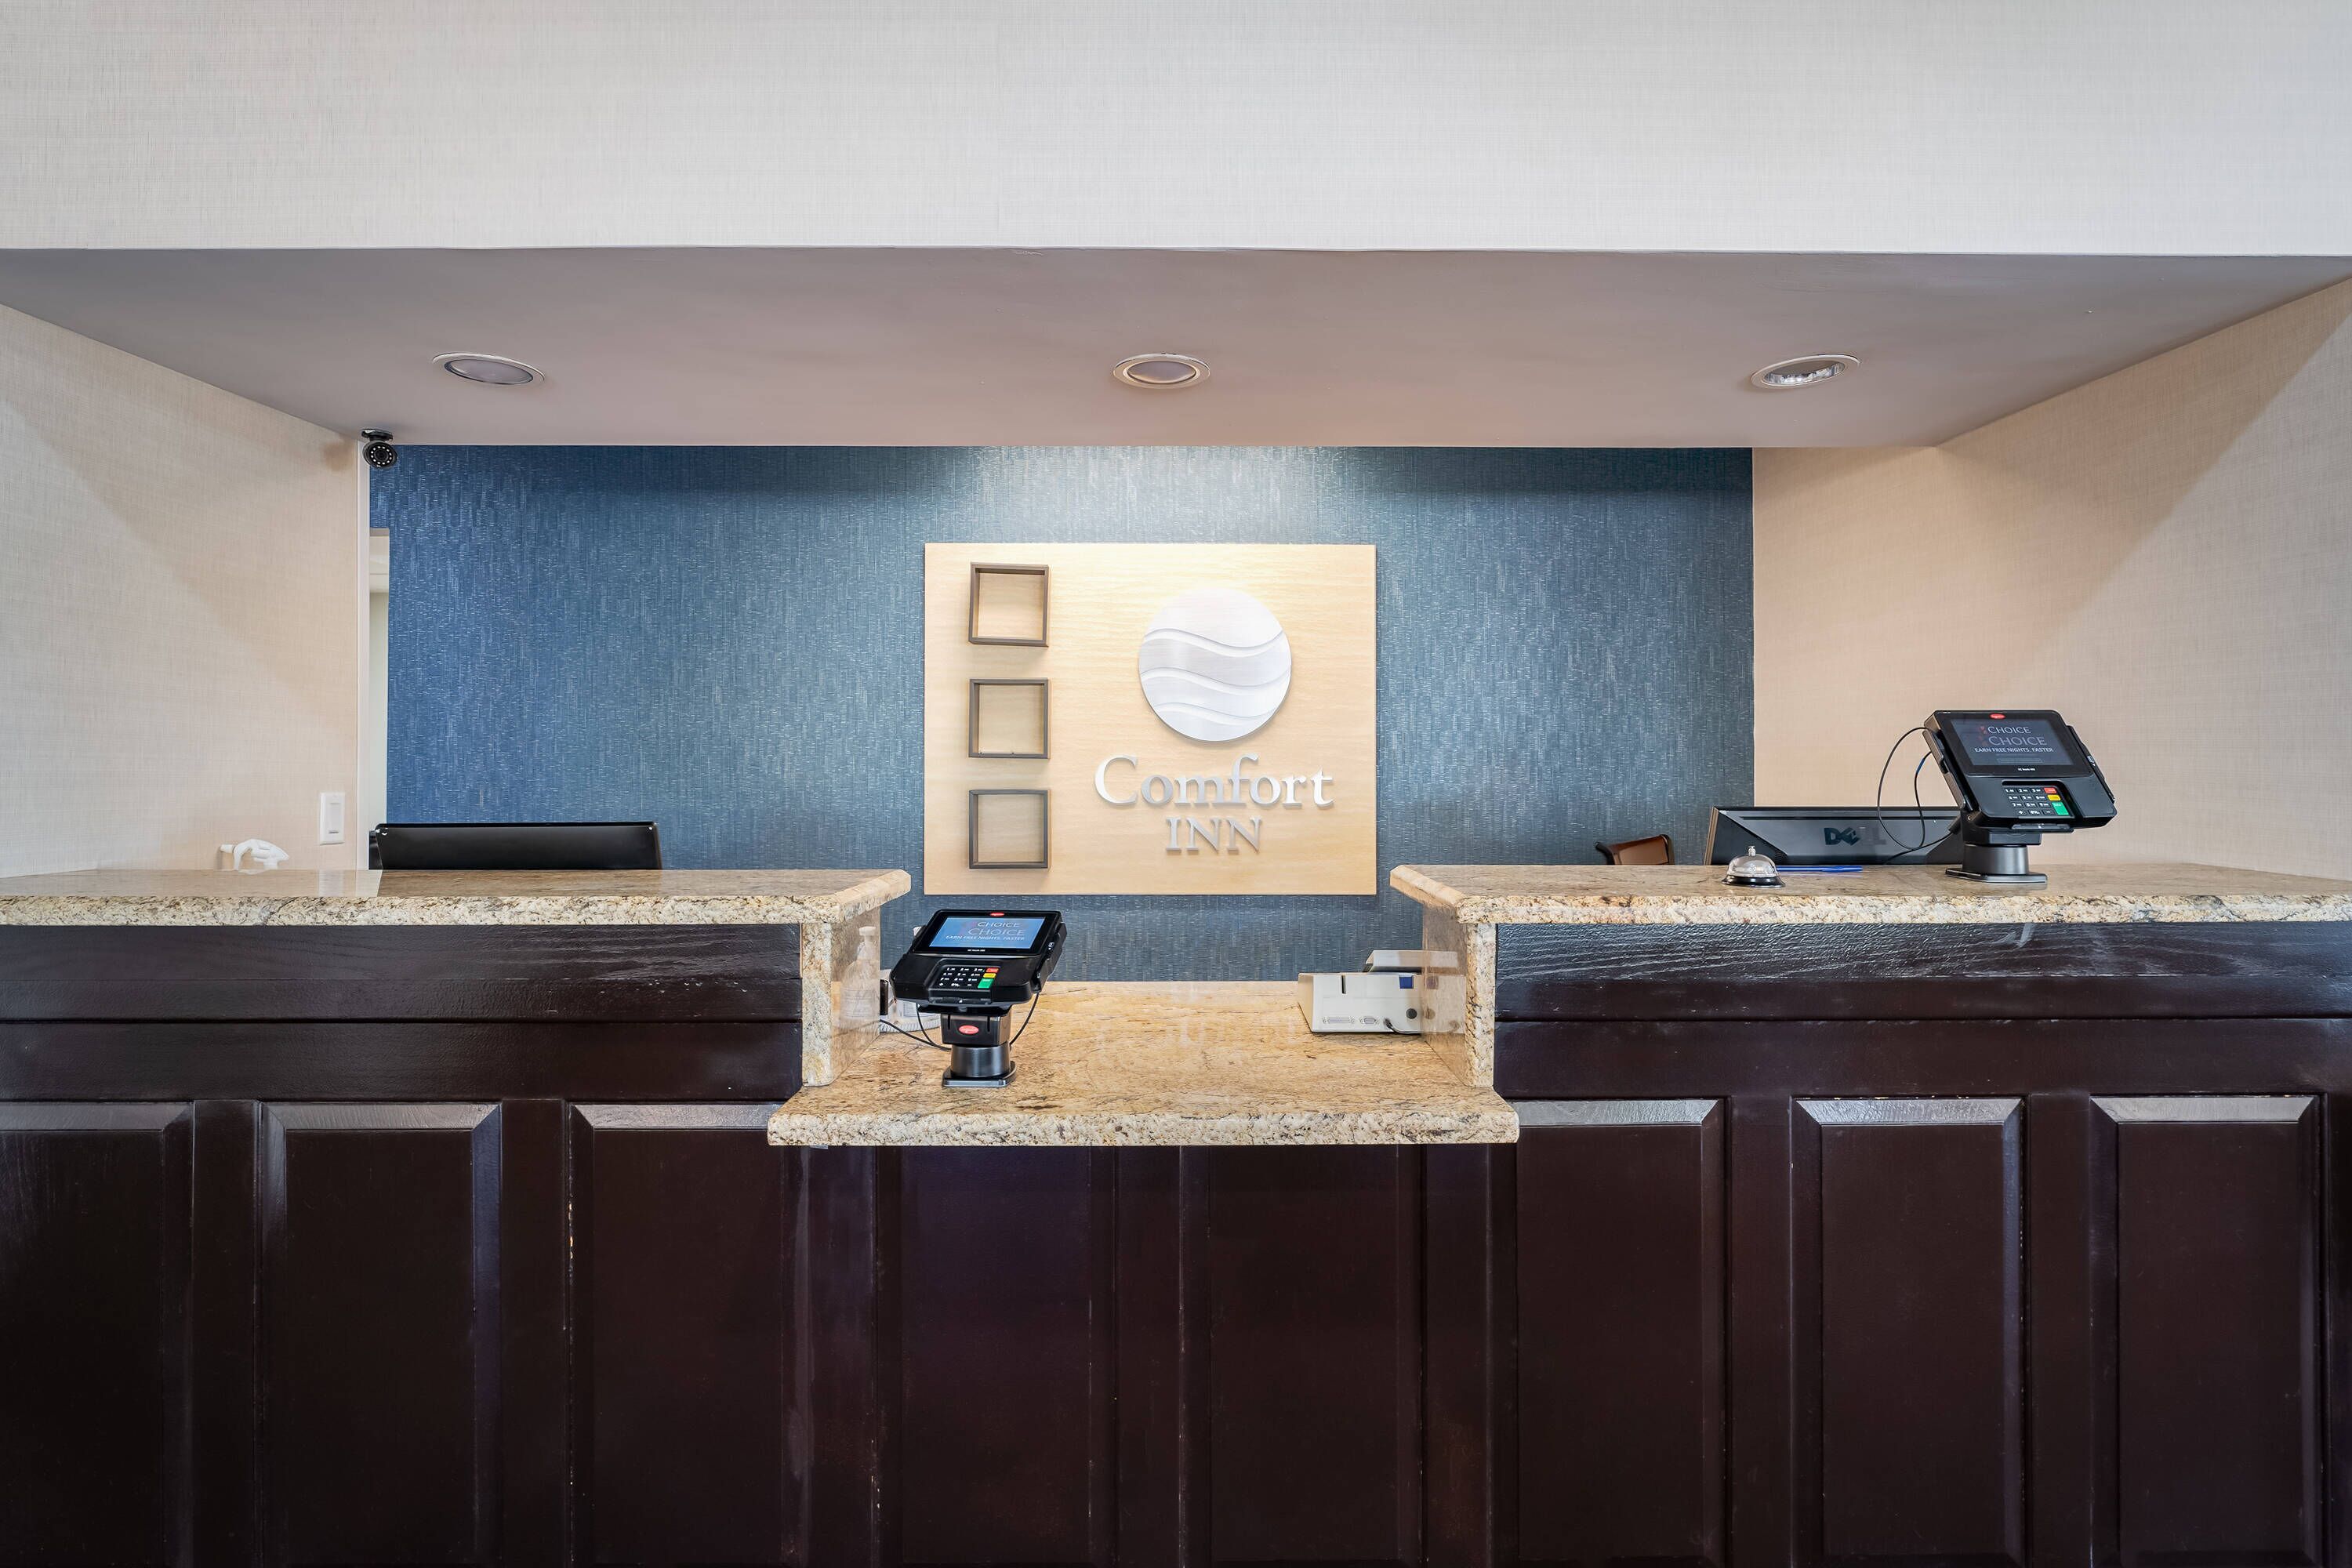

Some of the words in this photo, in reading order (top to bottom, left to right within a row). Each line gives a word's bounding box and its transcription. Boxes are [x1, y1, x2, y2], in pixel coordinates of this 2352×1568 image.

[1988, 735, 2048, 746] CHOICE
[1094, 753, 1334, 808] Comfort
[1165, 815, 1262, 855] INN
[967, 927, 1026, 936] CHOICE
